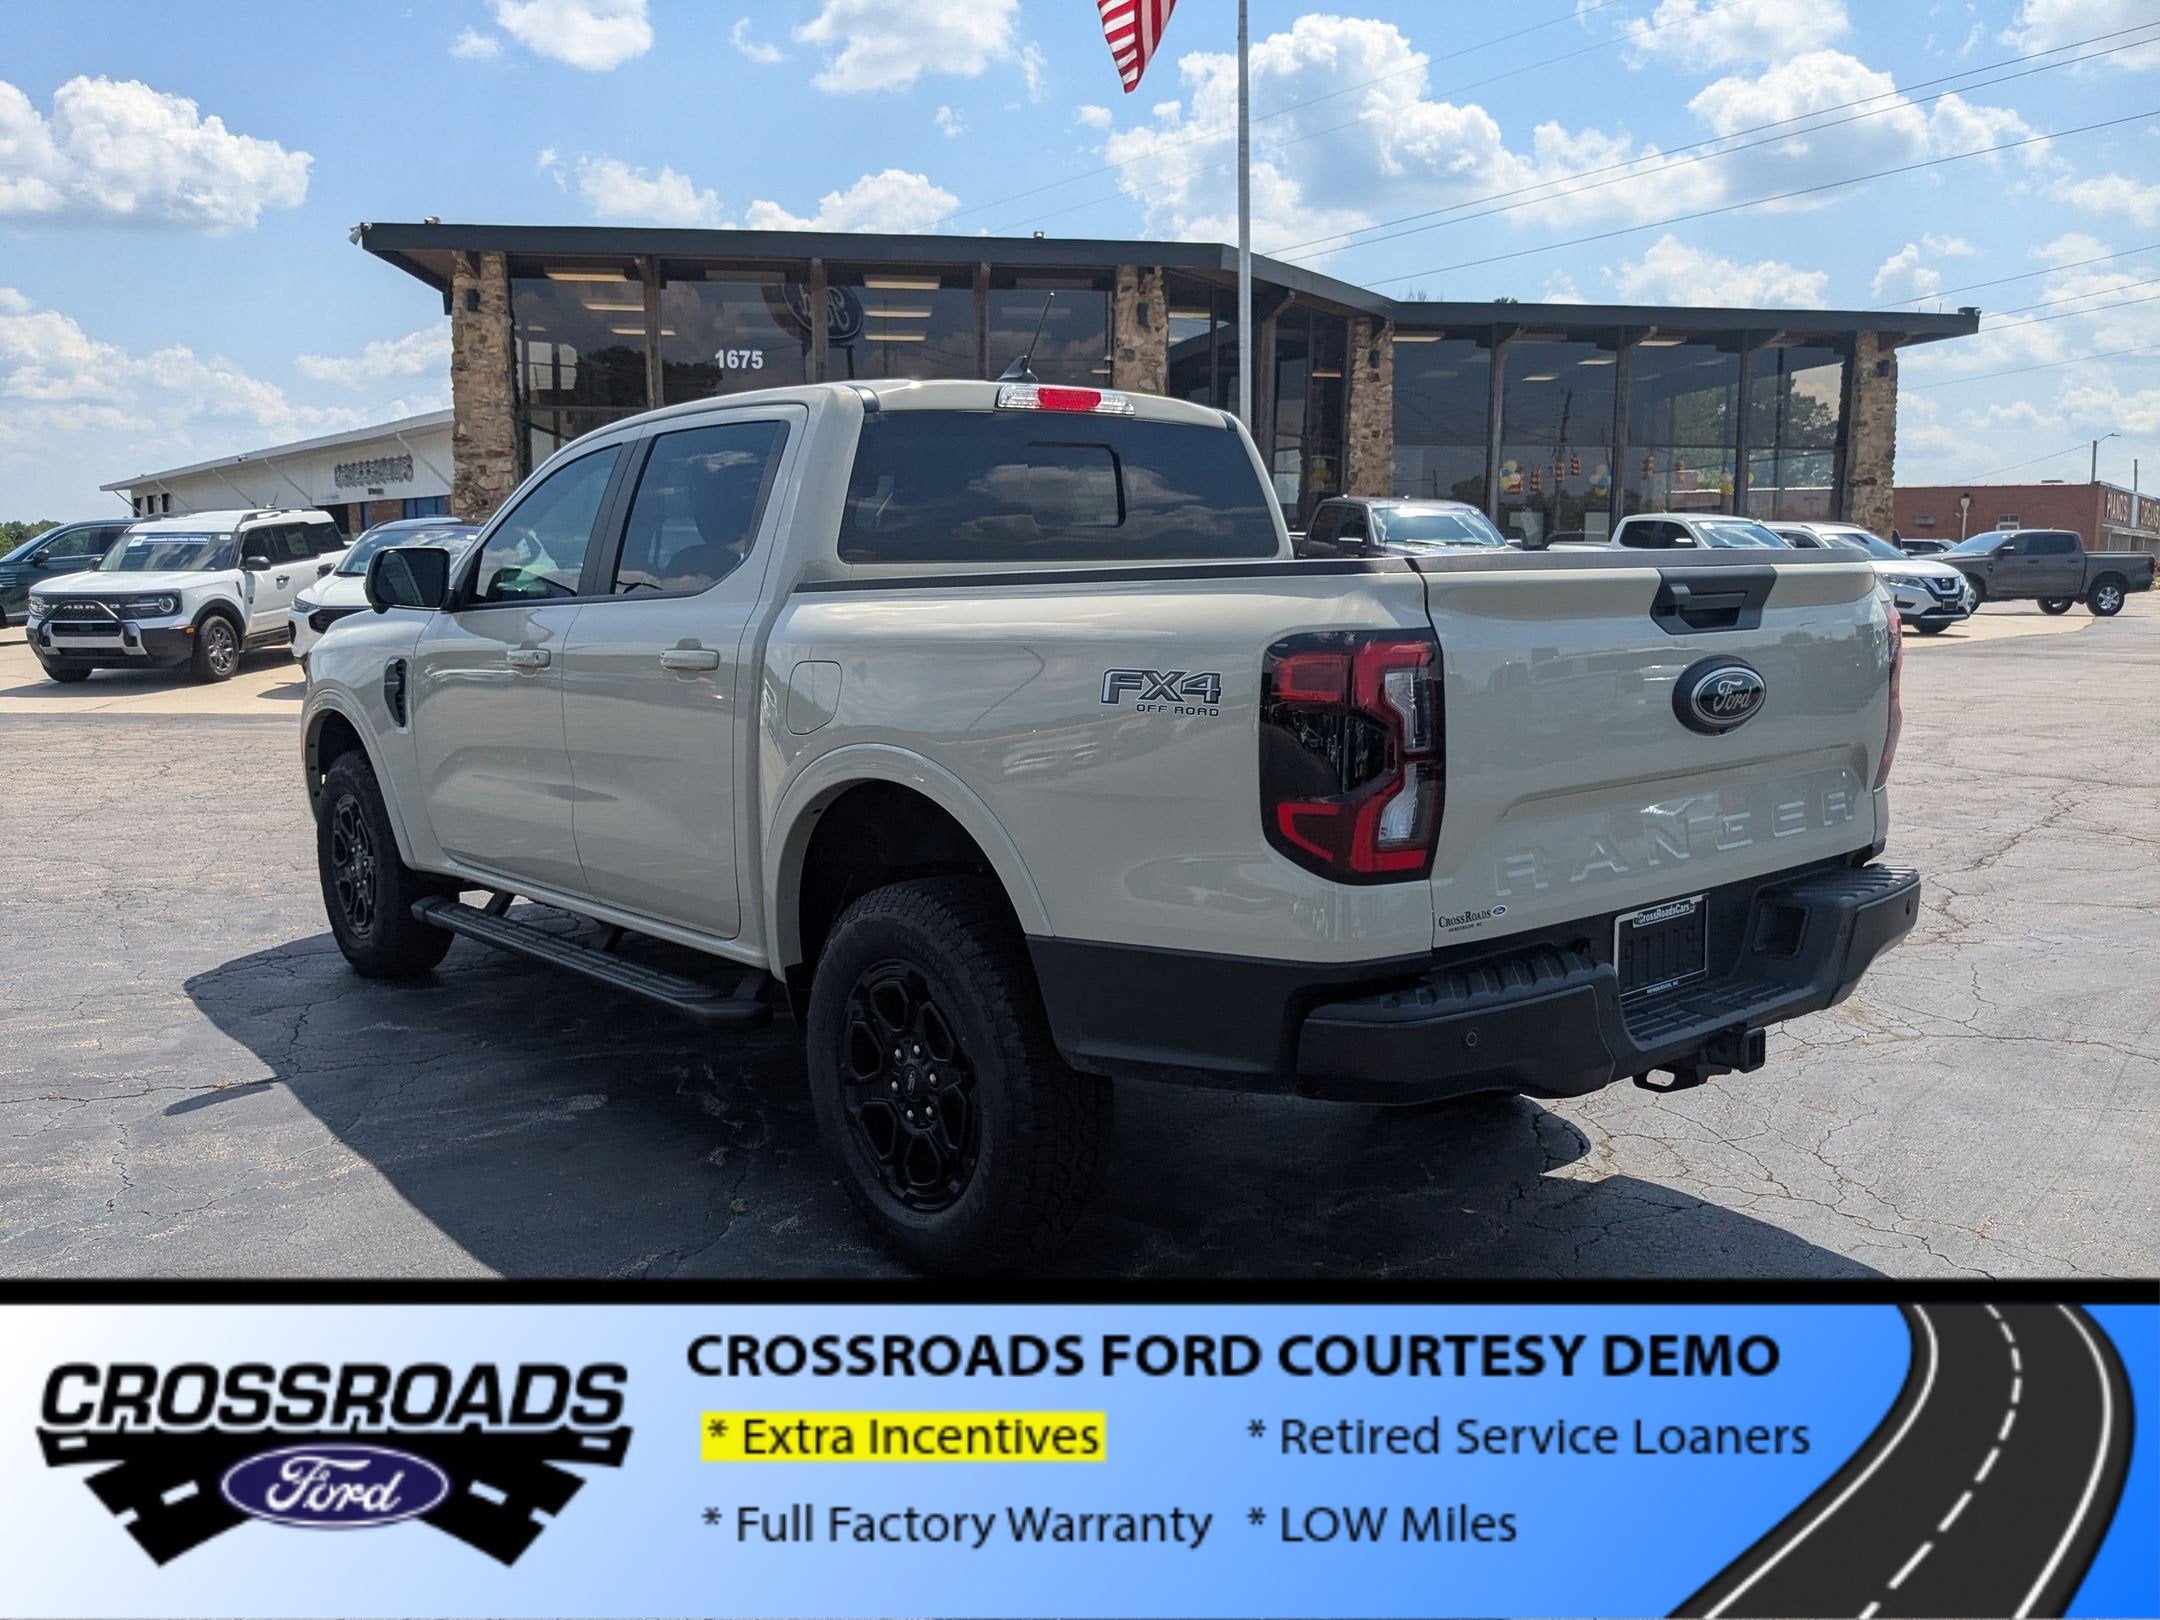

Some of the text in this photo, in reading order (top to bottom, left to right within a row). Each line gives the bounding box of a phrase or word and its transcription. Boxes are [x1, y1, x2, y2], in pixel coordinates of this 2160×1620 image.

[714, 349, 764, 370] 1675
[1100, 667, 1222, 706] FX4
[1712, 679, 1752, 712] Ford
[1136, 703, 1219, 717] OFF ROAD
